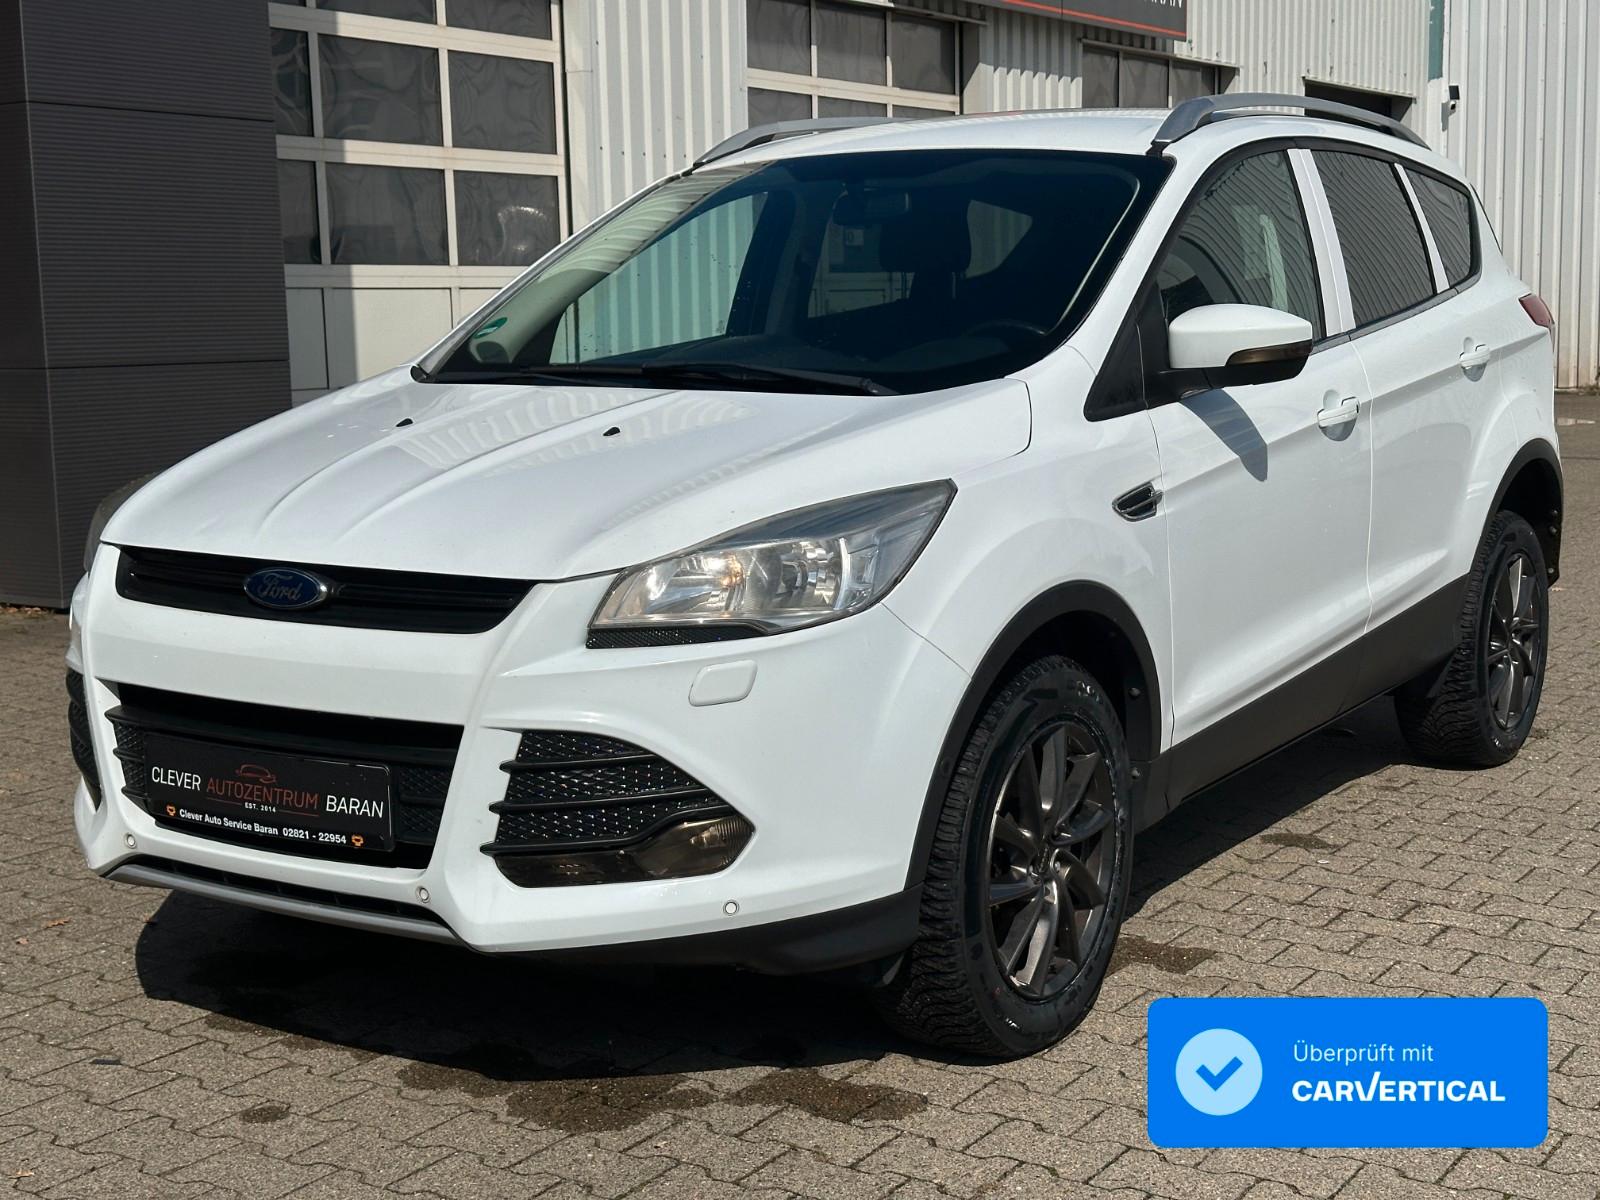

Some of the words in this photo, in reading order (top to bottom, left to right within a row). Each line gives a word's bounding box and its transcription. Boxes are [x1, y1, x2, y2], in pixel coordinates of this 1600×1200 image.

[257, 572, 303, 600] Ford
[151, 766, 201, 791] CLEVER
[206, 777, 319, 810] AUTOZENTRUM
[326, 794, 384, 819] BARAN
[244, 801, 259, 810] EST.
[260, 804, 276, 813] 2014
[179, 808, 203, 822] Clever
[204, 813, 222, 825] Auto
[223, 817, 252, 831] Service
[253, 822, 279, 835] Baran
[282, 827, 309, 840] 02821
[318, 832, 347, 844] 22954
